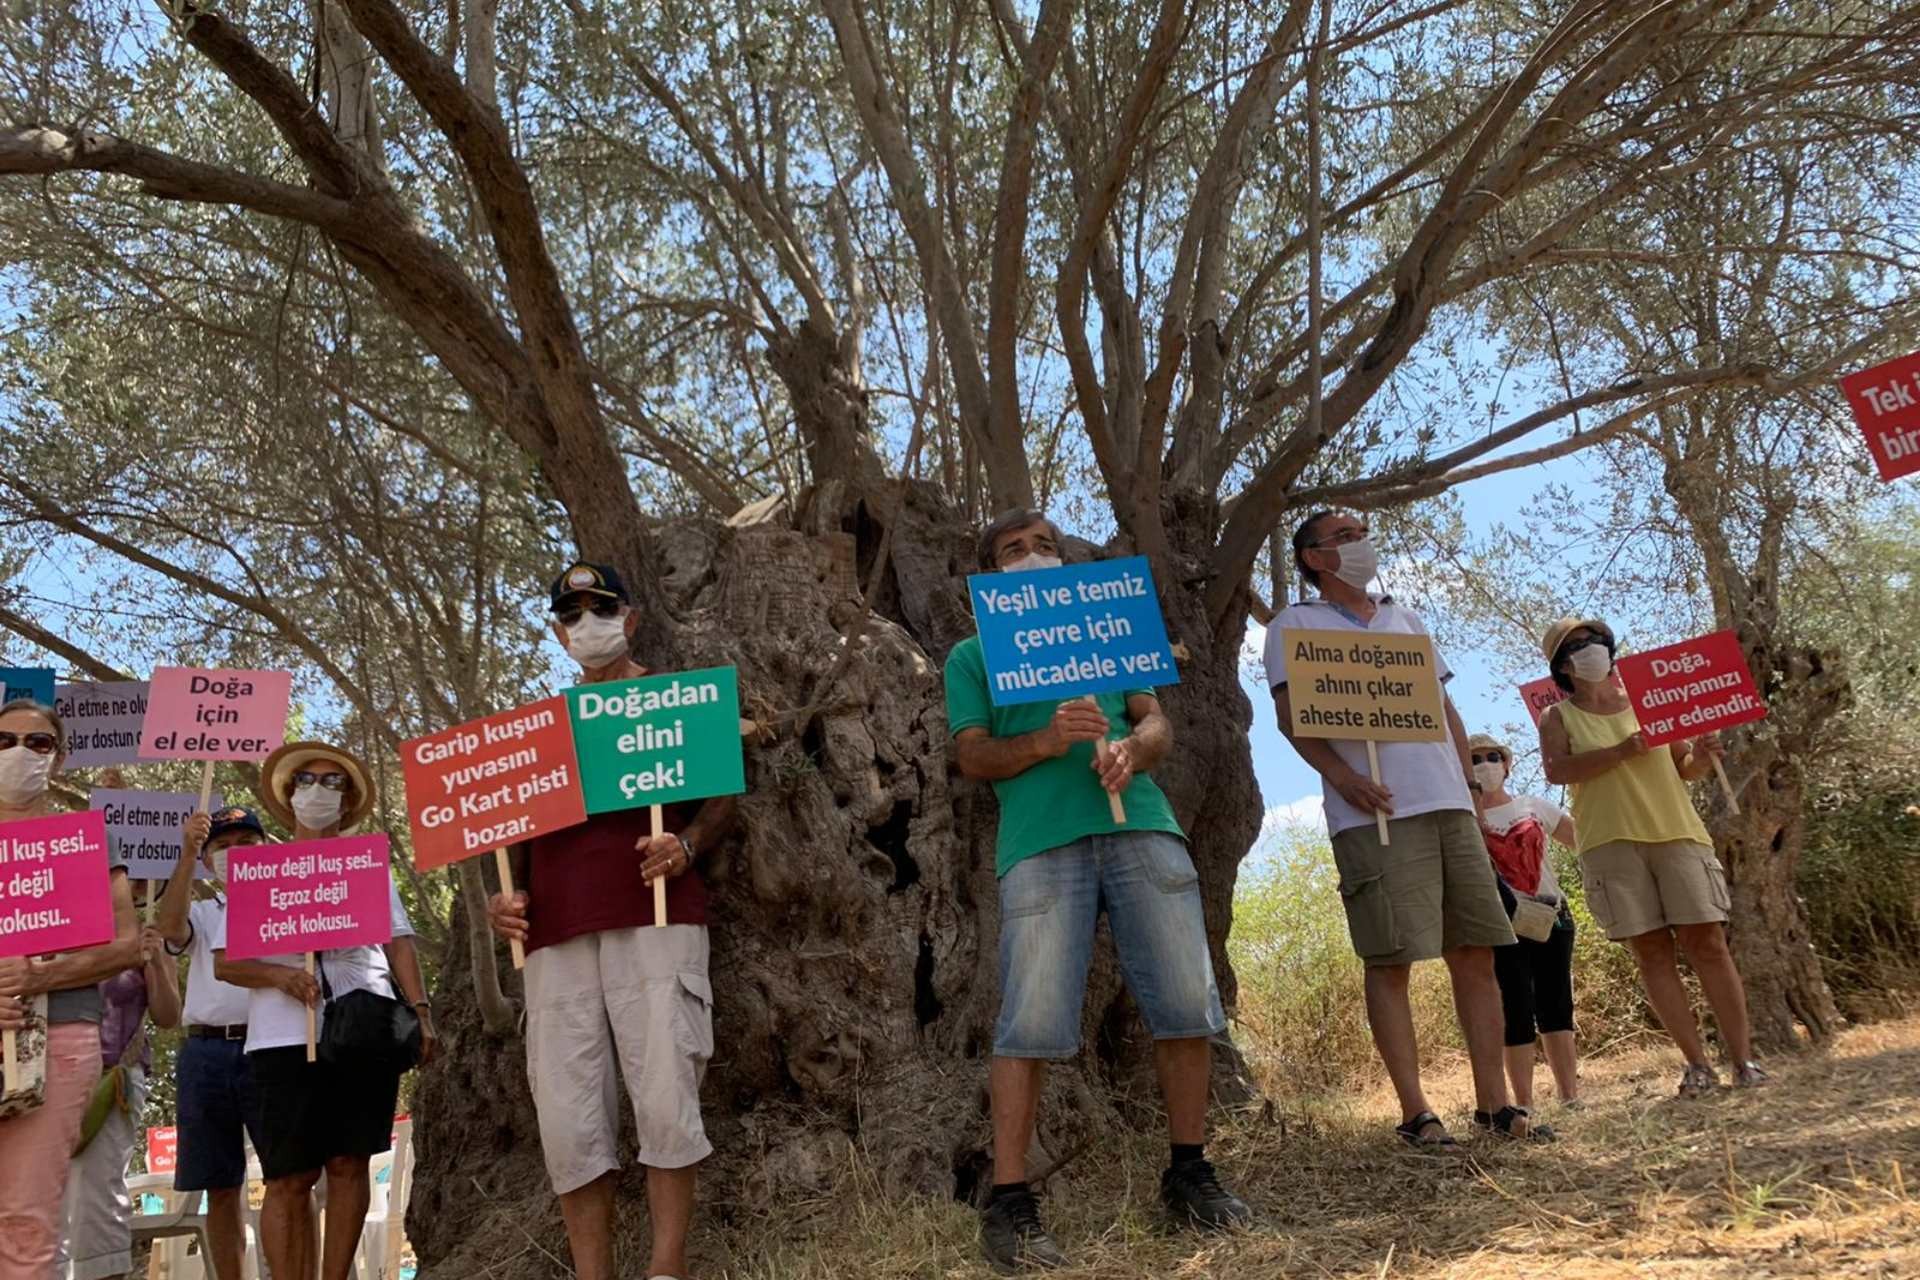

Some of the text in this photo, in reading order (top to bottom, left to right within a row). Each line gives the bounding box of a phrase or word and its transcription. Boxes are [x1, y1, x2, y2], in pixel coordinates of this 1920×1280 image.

[1861, 379, 1917, 415] Tek
[979, 572, 1147, 616] Yeşil ve temiz
[1014, 612, 1133, 655] çevre için
[995, 650, 1169, 692] mücadele ver.
[1295, 641, 1425, 668] Alma doğanın
[1651, 652, 1712, 678] Doğa,
[189, 675, 254, 699] Doğa
[578, 681, 719, 721] Doğadan
[1315, 673, 1414, 700] ahını çıkar
[1641, 671, 1742, 709] dünyamızı
[55, 697, 76, 718] Gel
[78, 699, 107, 717] etme
[112, 699, 127, 715] ne
[195, 704, 239, 726] için
[1300, 704, 1439, 730] aheste aheste.
[1642, 693, 1761, 737] var edendir.
[91, 728, 134, 749] dostun
[154, 731, 178, 750] el
[183, 733, 221, 751] ele
[227, 738, 270, 753] ver.
[414, 709, 555, 765] Garip kuşun
[616, 720, 685, 754] elini
[441, 748, 538, 793] yuvasını
[618, 760, 685, 800] çek!
[420, 764, 570, 829] Go Kart pisti
[104, 803, 125, 825] Gel
[128, 805, 160, 827] etme
[163, 808, 179, 826] ne
[12, 838, 46, 863] kuş
[49, 828, 99, 856] sesi...
[137, 837, 181, 861] dostun
[463, 817, 536, 851] bozar.
[232, 849, 383, 882] Motor değil kuş sesi...
[9, 867, 54, 898] değil
[270, 880, 348, 910] Egzoz değil
[259, 912, 359, 943] çiçek kokusu..
